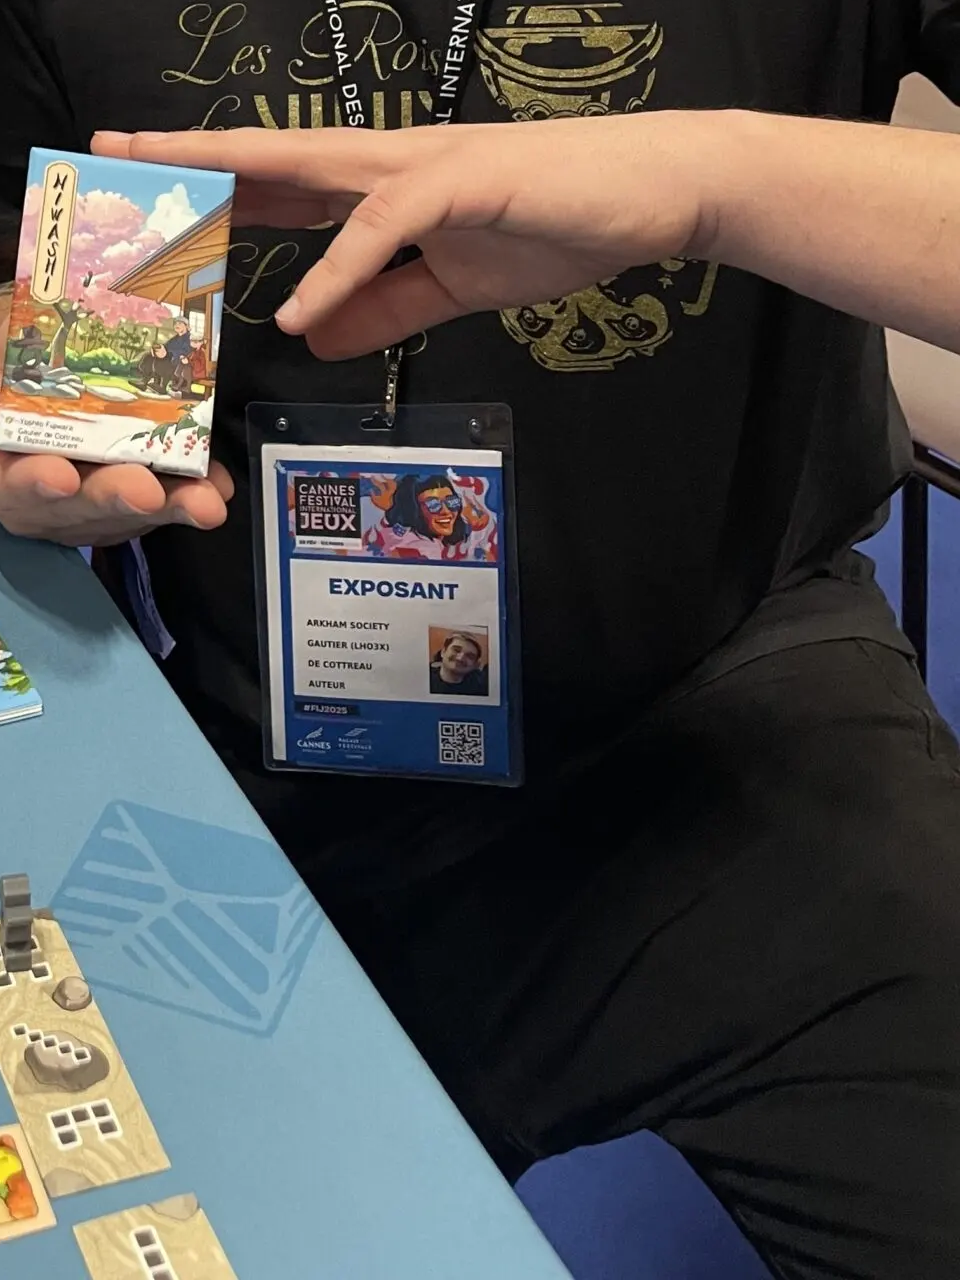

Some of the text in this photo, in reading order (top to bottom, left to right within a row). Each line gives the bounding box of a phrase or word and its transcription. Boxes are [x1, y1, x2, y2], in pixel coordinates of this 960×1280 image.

[161, 0, 441, 86] Les Rois
[342, 83, 365, 127] DES
[43, 172, 68, 293] NIWASHI
[299, 483, 356, 496] CANNES
[299, 495, 356, 507] FESTIVAL
[300, 506, 356, 514] INTERNATIONAL
[300, 513, 356, 531] JEUX
[329, 578, 459, 600] EXPOSANT
[306, 619, 390, 631] ARKHAM SOCIETY
[307, 639, 348, 650] GAUTIER
[308, 659, 373, 671] DE COTTREAU
[308, 680, 346, 690] AUTEUR
[304, 704, 348, 714] #FIJ2025
[297, 739, 332, 750] CANNES
